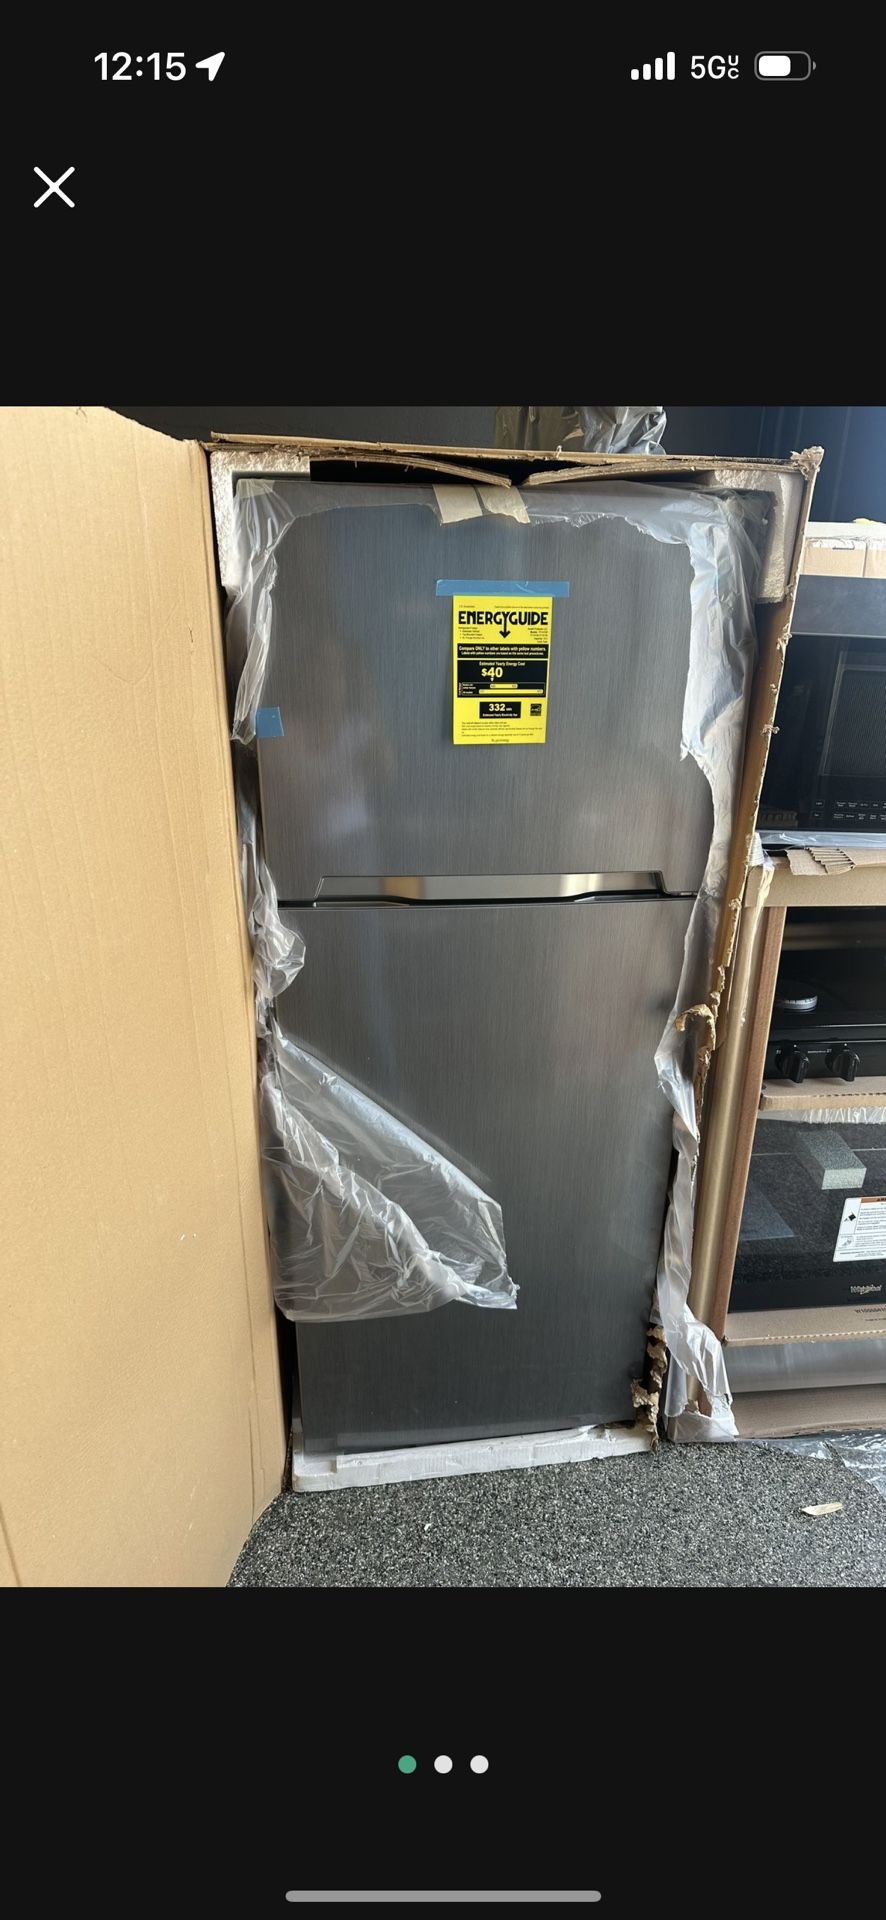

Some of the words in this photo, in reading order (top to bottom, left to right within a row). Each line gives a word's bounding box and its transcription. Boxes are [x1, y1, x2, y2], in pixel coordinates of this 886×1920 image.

[458, 610, 549, 626] ENERGYGUIDE
[481, 666, 503, 678] $40
[489, 703, 506, 712] 332
